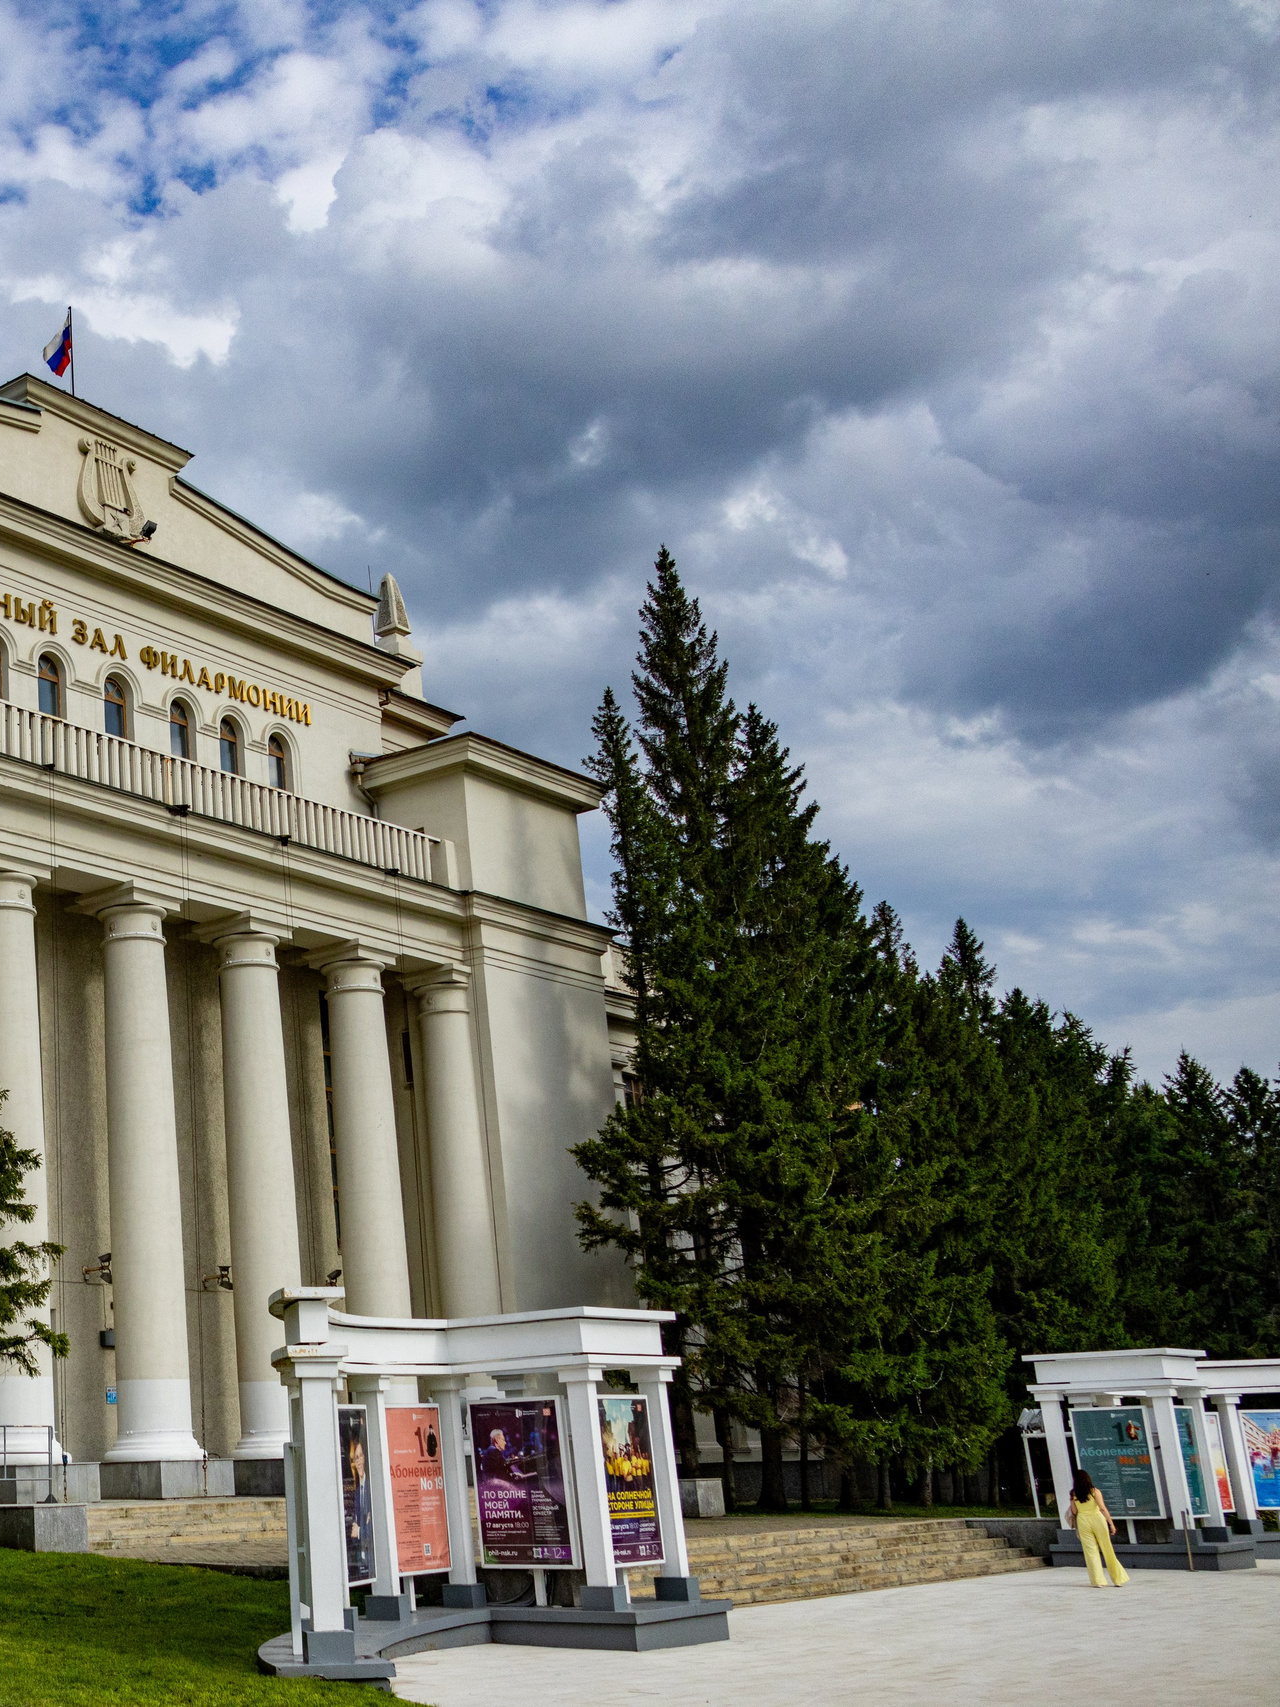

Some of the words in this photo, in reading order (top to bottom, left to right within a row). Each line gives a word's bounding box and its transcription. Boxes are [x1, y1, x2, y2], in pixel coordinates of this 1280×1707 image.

[71, 618, 128, 660] ЗАЛ
[139, 645, 312, 725] ФИЛАРМОНИИ
[1080, 1447, 1148, 1457] Абонемент
[390, 1463, 442, 1479] Абонемент
[497, 1490, 527, 1499] ВОЛНЕ
[616, 1488, 652, 1500] СОЛНЕЧНОЙ
[484, 1499, 510, 1510] МОЕЙ
[634, 1500, 654, 1510] УЛИЦЫ
[553, 1547, 566, 1559] 12+
